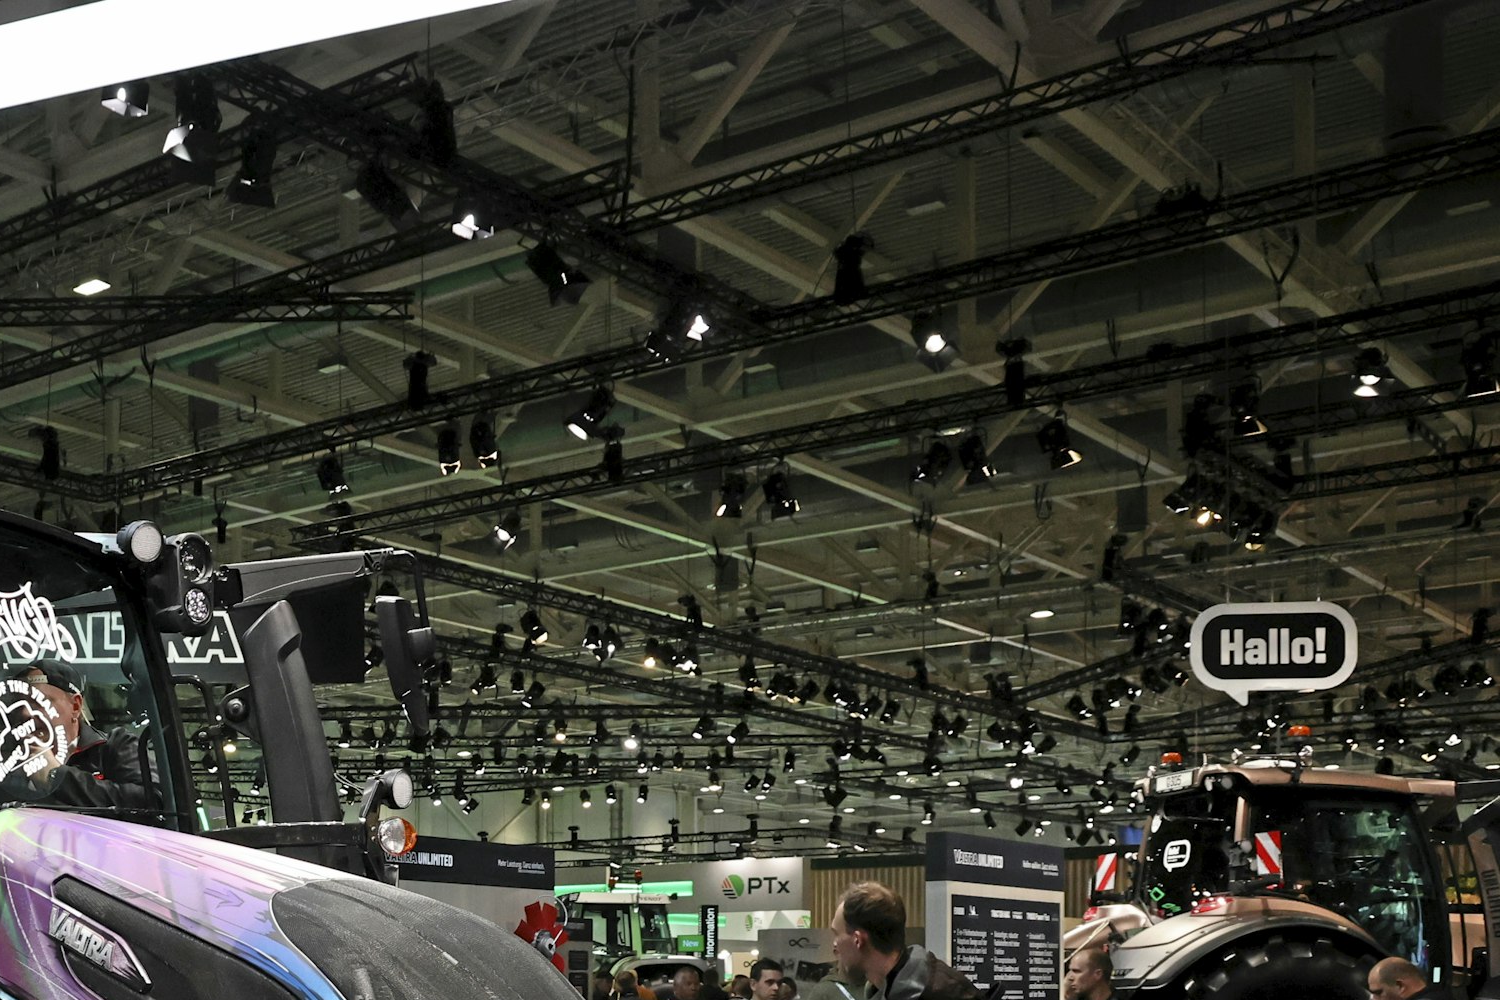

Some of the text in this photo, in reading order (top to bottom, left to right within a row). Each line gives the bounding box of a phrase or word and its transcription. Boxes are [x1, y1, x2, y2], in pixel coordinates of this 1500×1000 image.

[1220, 627, 1327, 666] Hallo!
[7, 680, 30, 695] THE
[31, 686, 60, 719] YEAR
[11, 719, 36, 741] TOTY
[23, 755, 48, 777] 2026
[418, 853, 453, 867] UNLIMITED
[748, 877, 790, 894] PTx
[49, 906, 115, 972] VALTRA
[705, 908, 715, 957] Information
